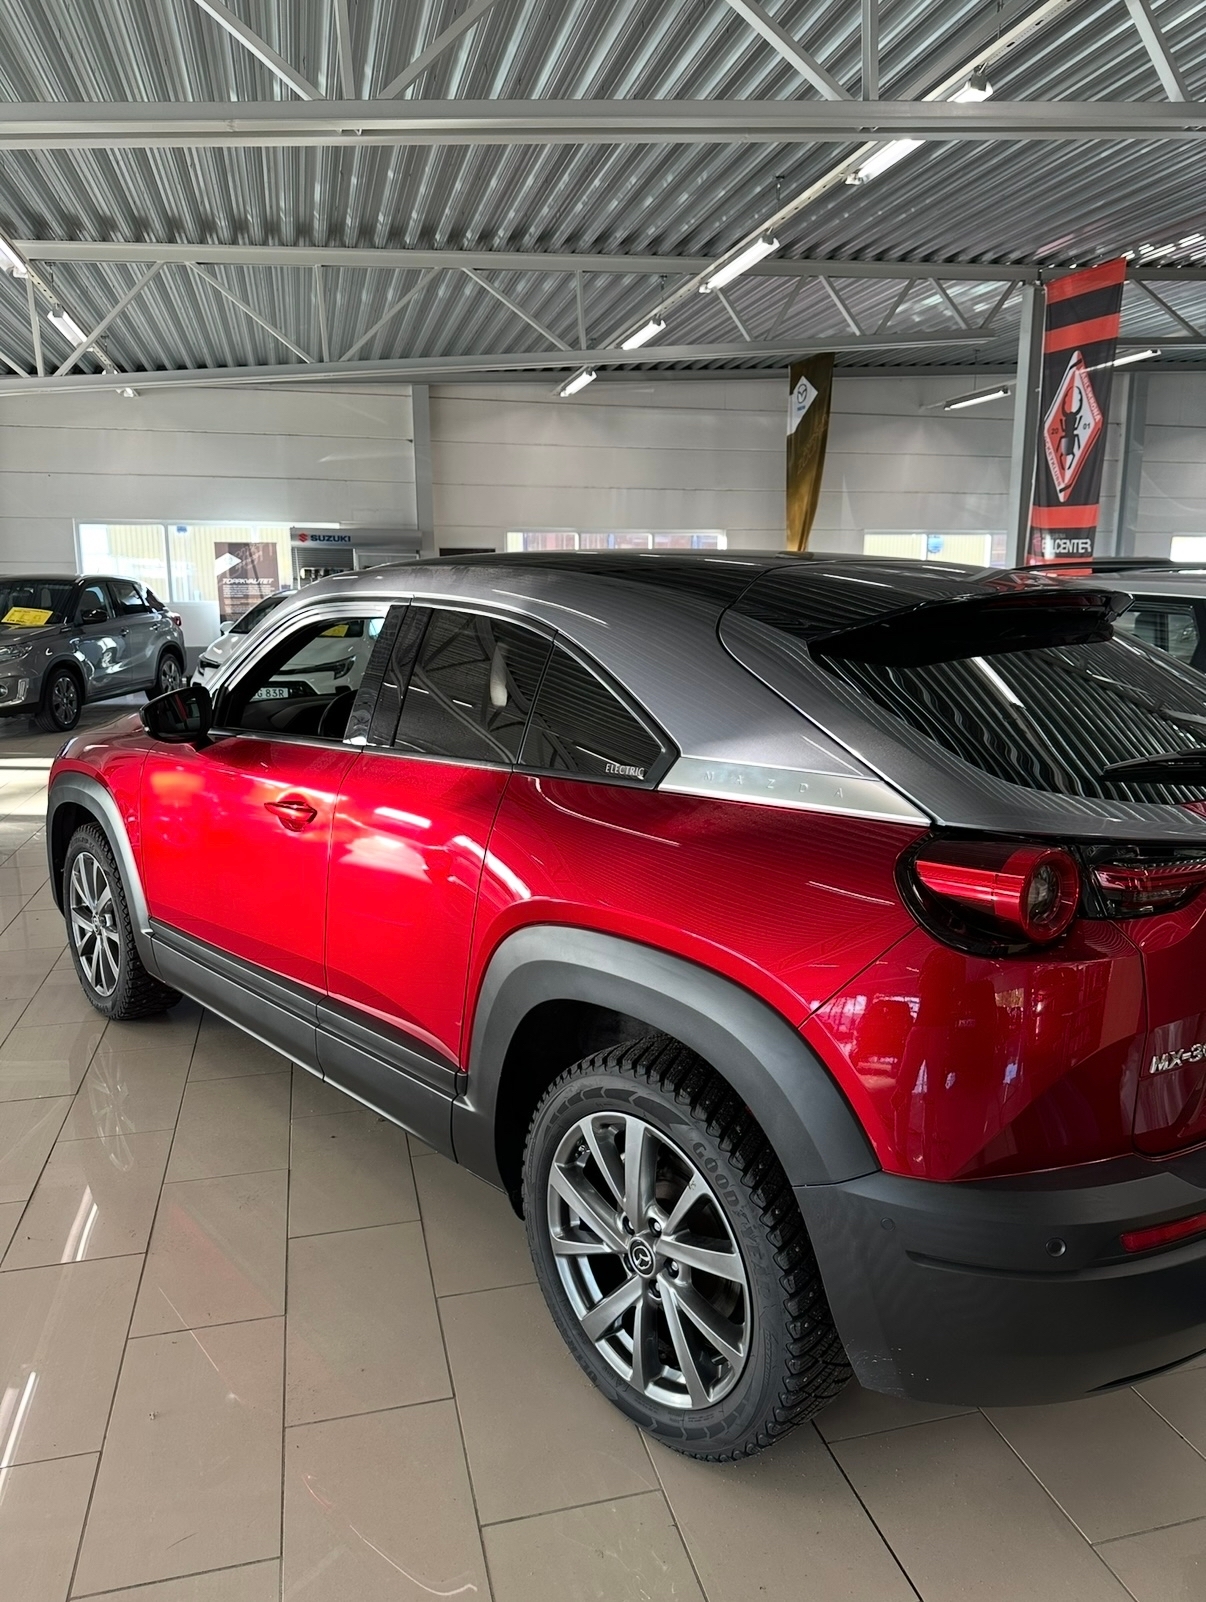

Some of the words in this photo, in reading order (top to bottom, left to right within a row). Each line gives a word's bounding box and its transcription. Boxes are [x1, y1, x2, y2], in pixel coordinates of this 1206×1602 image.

[1083, 422, 1091, 430] 01
[310, 534, 351, 543] SUZUKI
[1042, 538, 1092, 553] BLCENTER
[265, 688, 285, 698] 83R
[605, 763, 645, 778] ELECTRIC
[703, 770, 844, 799] MAZDA
[1149, 1043, 1206, 1074] MX-3
